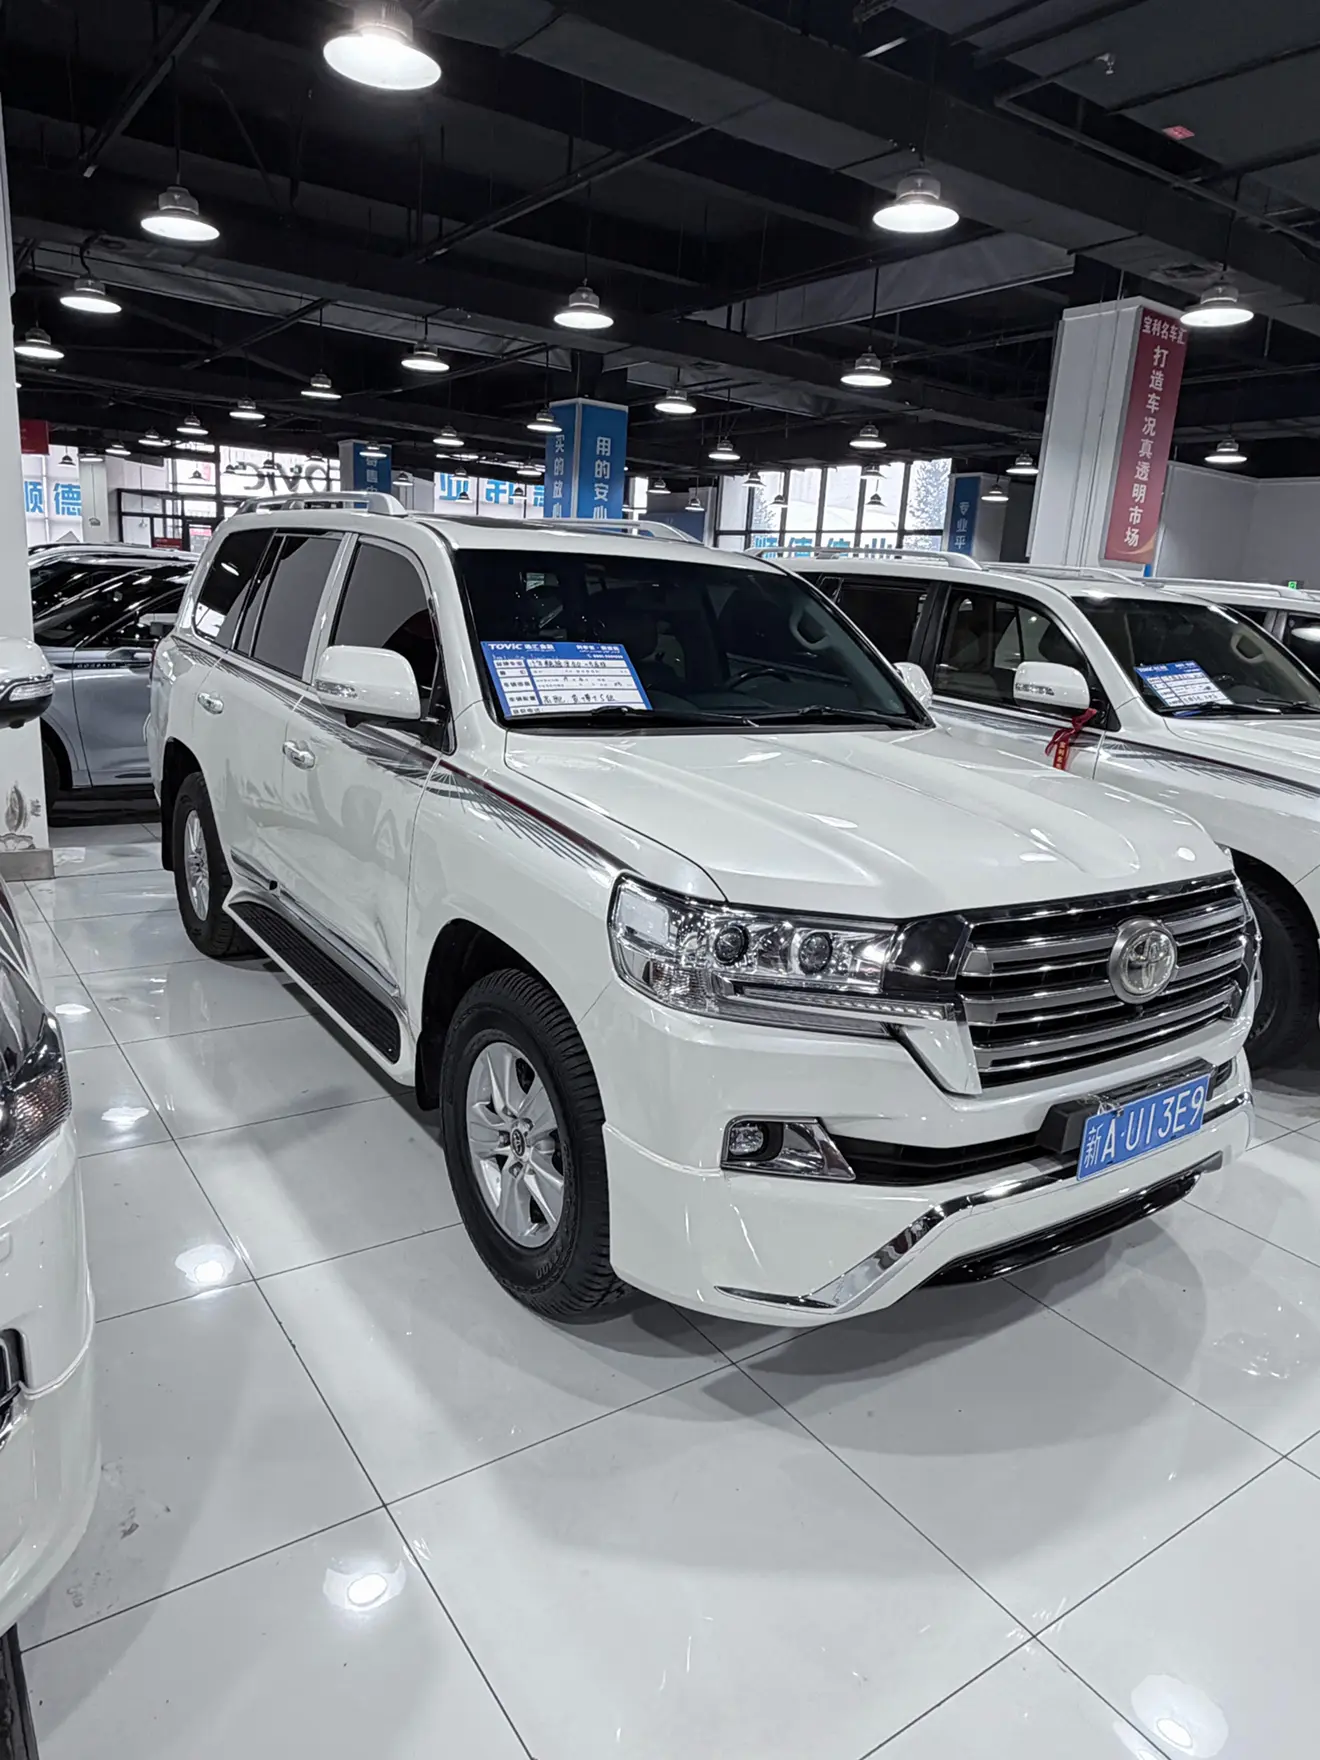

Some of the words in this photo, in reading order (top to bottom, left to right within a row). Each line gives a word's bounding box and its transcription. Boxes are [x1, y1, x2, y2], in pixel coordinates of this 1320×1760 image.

[1124, 345, 1169, 548] 打造车况真透明市场
